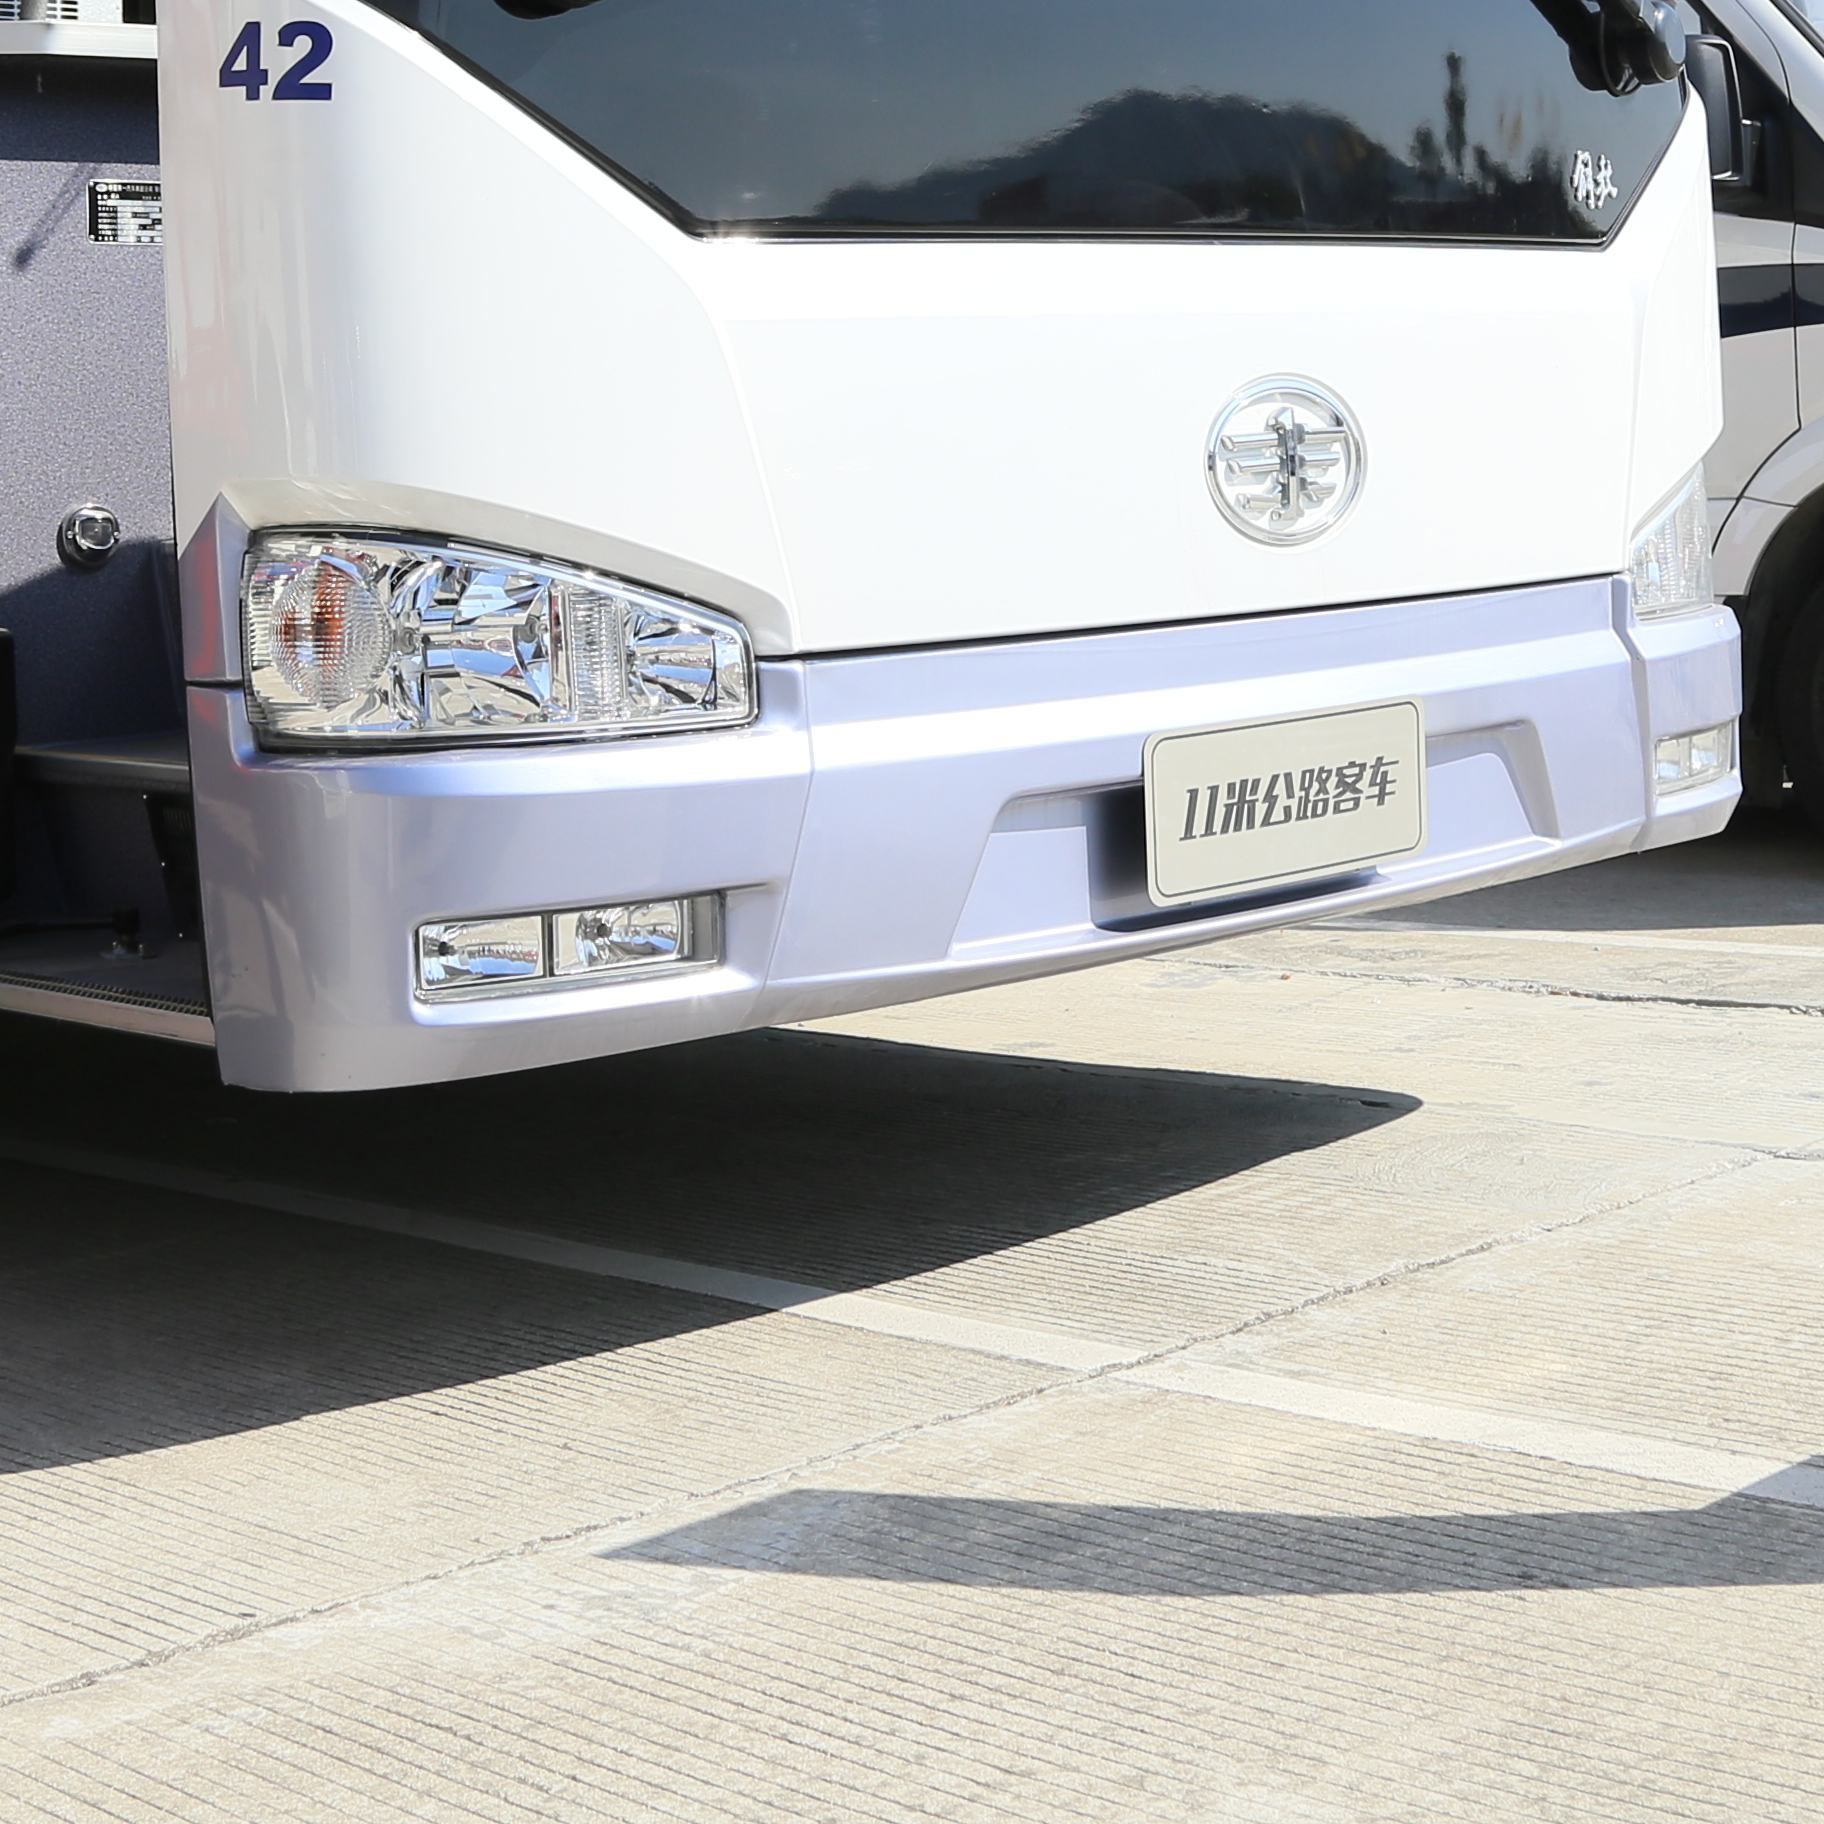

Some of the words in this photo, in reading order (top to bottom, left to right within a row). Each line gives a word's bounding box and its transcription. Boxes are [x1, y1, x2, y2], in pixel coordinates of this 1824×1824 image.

[219, 21, 333, 100] 42
[1179, 755, 1400, 842] 11米公路客车
